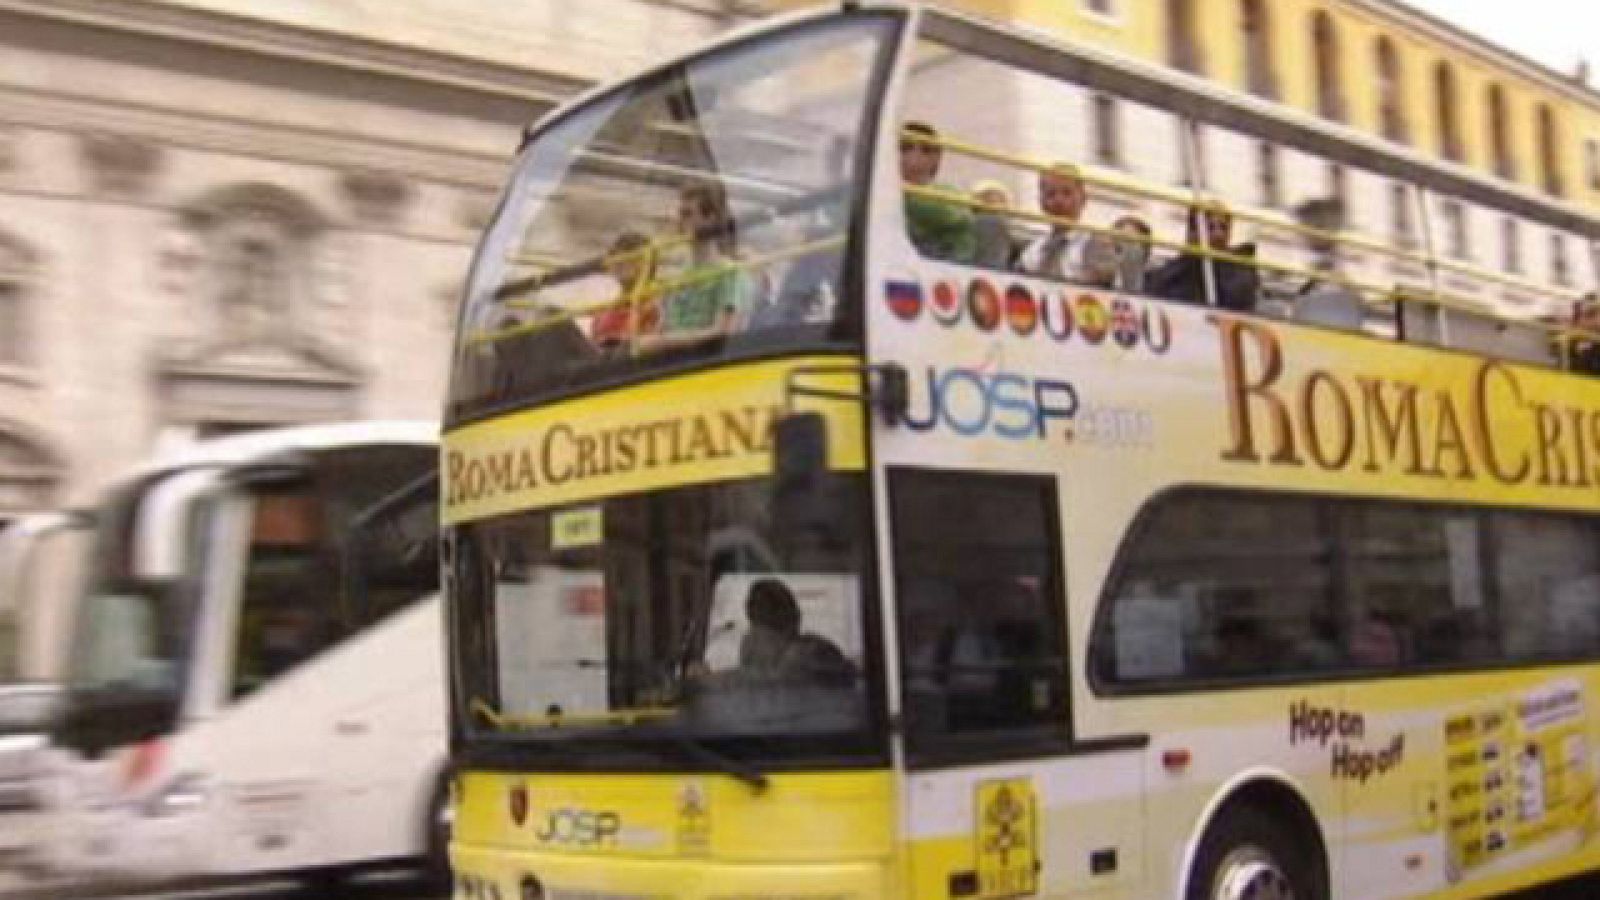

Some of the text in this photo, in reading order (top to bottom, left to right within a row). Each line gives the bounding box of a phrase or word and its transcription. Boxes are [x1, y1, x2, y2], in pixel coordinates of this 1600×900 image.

[1289, 698, 1363, 748] Hop on
[1331, 743, 1376, 785] Hop
